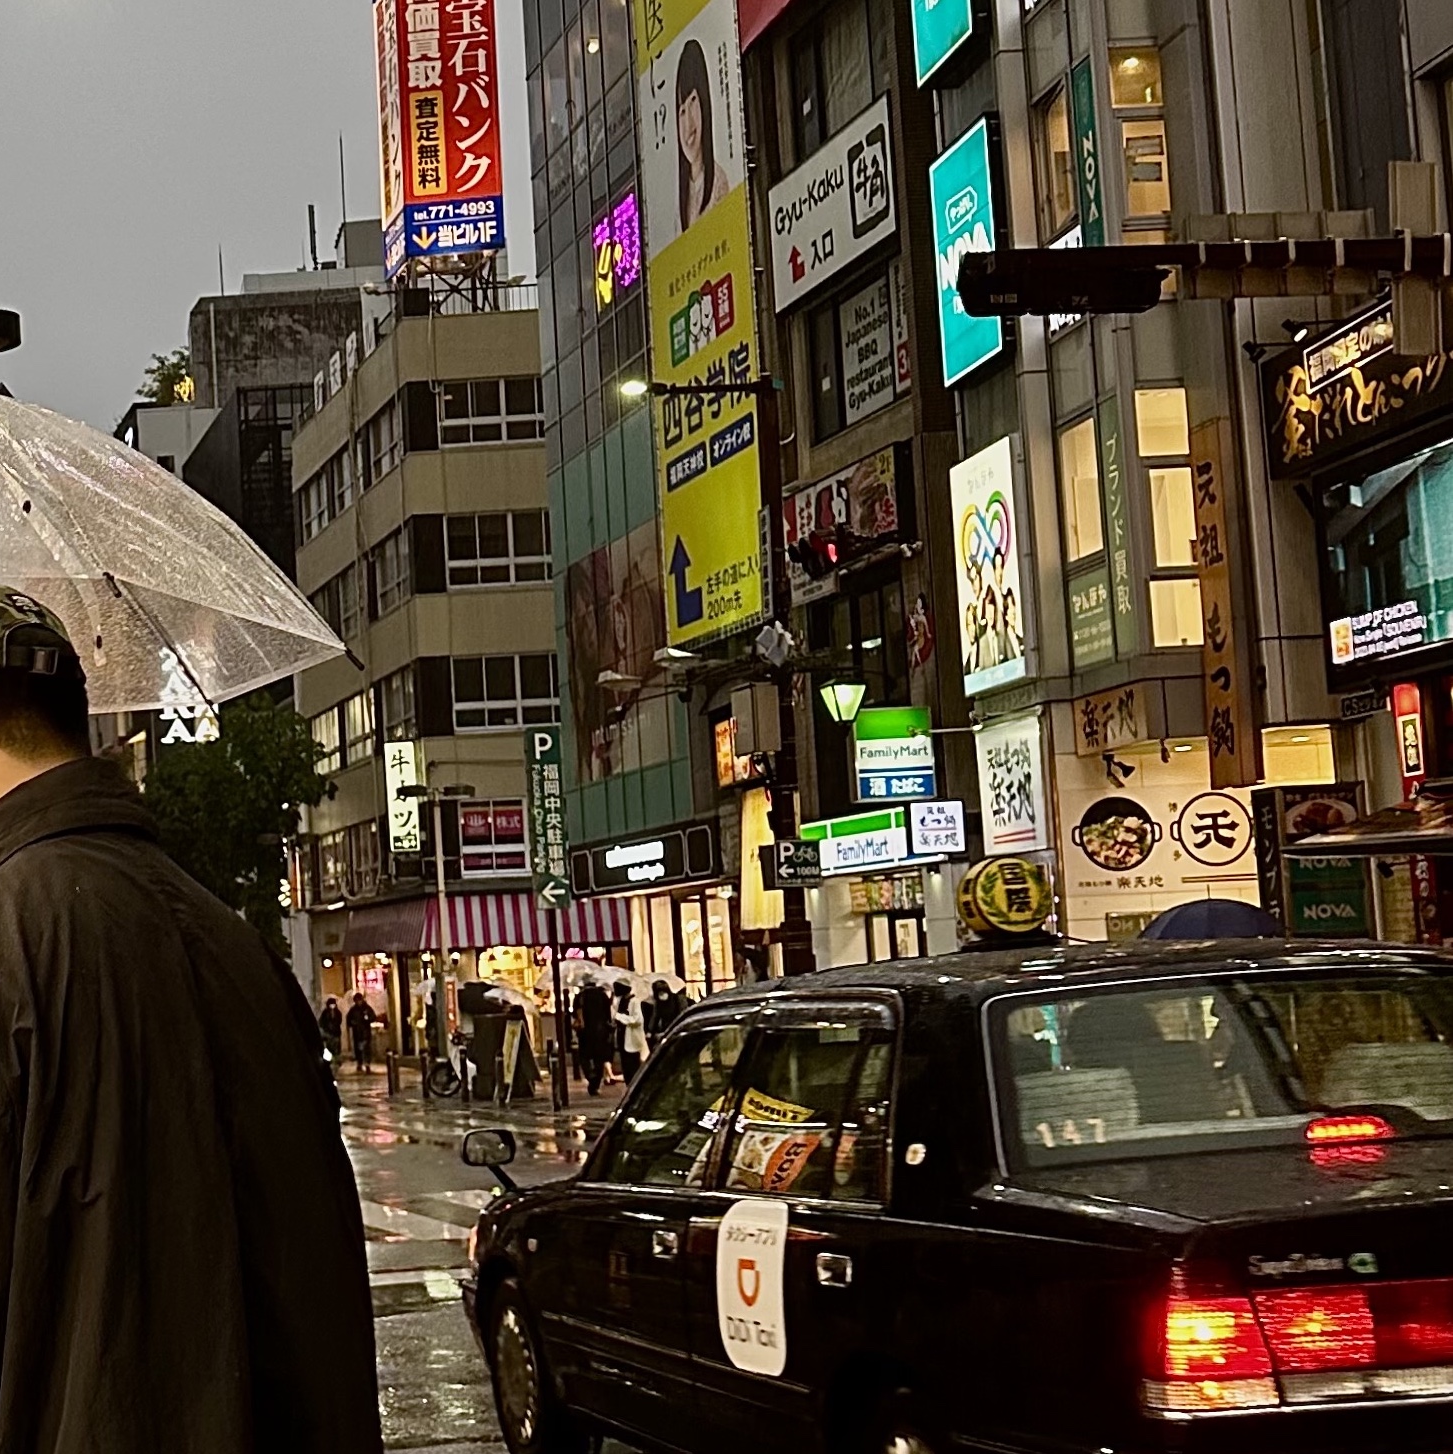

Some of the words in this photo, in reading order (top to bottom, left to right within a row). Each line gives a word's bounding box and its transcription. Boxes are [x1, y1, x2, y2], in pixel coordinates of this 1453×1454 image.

[404, 0, 443, 88] 価買取
[415, 97, 441, 189] 査定無料
[1081, 131, 1100, 223] NOVA
[413, 201, 495, 221] tel.771-4993
[774, 165, 844, 235] Gyu-Kaku
[438, 222, 497, 248] 当ビル1F
[810, 228, 834, 270] 入口
[855, 297, 875, 325] No.1
[845, 311, 889, 348] Japanese
[857, 338, 878, 364] BBQ
[534, 733, 552, 760] P
[860, 745, 929, 760] FamilyMart
[869, 777, 886, 796] 酒
[891, 777, 925, 794] たばこ
[780, 842, 794, 863] P
[836, 838, 889, 864] FamilyMart
[1303, 904, 1357, 921] NOVA
